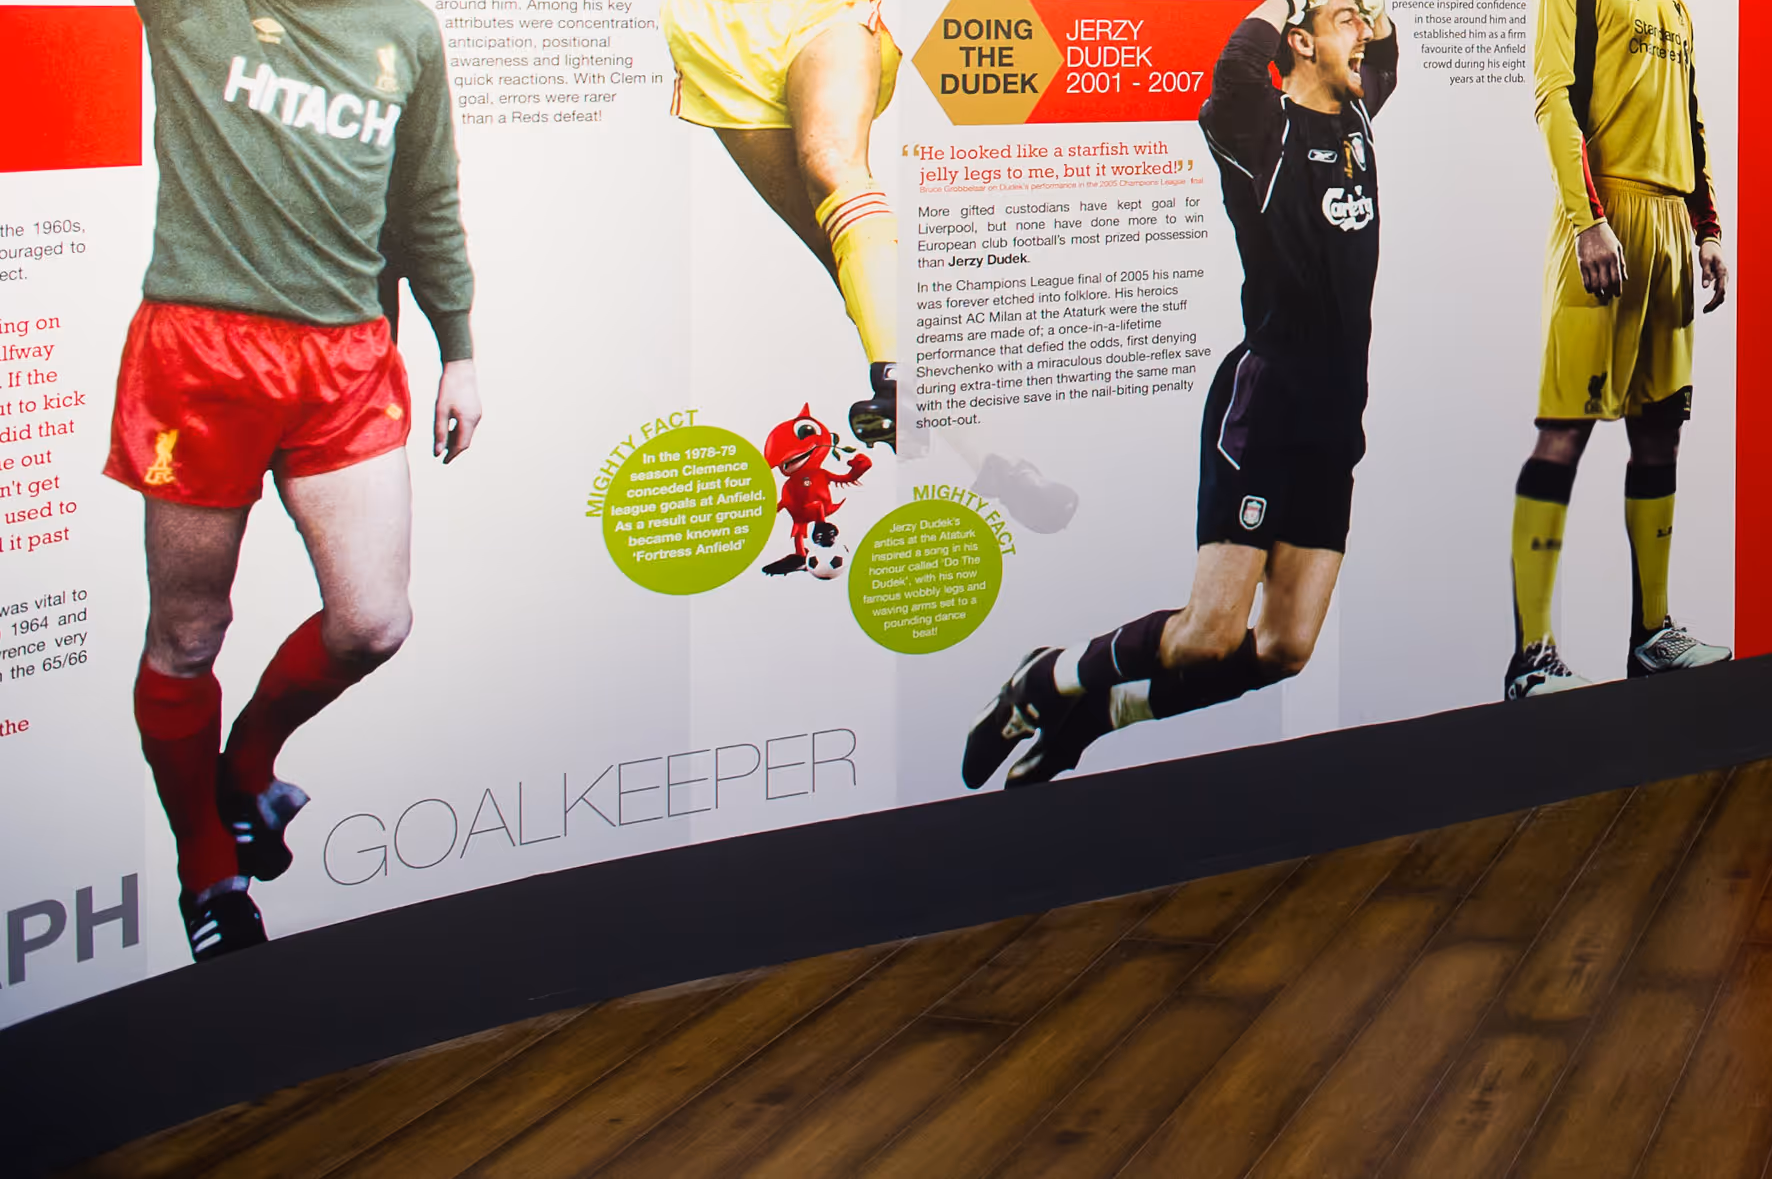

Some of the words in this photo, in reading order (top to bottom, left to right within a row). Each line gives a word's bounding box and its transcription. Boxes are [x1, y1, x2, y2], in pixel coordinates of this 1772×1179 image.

[944, 19, 1032, 40] DOING
[1066, 19, 1144, 41] JERZY
[959, 46, 1014, 67] THE
[1066, 46, 1152, 68] DUDEK
[941, 73, 1039, 94] DUDEK
[1066, 72, 1120, 93] 2001
[1149, 71, 1204, 92] 2007
[919, 167, 959, 185] jelly
[964, 166, 1001, 184] legs
[1007, 167, 1022, 179] to
[1028, 168, 1058, 180] me,
[1063, 164, 1091, 177] but
[1096, 163, 1106, 176] it
[34, 220, 85, 234] 1960s,
[918, 258, 944, 268] than
[948, 256, 983, 268] Jerzy
[988, 253, 1030, 265] Dudek.
[8, 371, 21, 388] If
[27, 369, 57, 385] the
[19, 400, 36, 413] to
[43, 391, 85, 410] kick
[586, 434, 636, 517] MIGHTY
[640, 409, 698, 439] FACT
[643, 454, 655, 464] In
[659, 452, 680, 462] the
[684, 445, 736, 460] 1978-79
[630, 469, 678, 481] season
[682, 462, 748, 476] Clemence
[626, 480, 693, 498] conceded
[696, 478, 721, 493] just
[724, 477, 752, 488] four
[611, 504, 656, 516] league
[660, 497, 696, 513] goals
[700, 495, 713, 507] at
[716, 490, 765, 508] Anfield.
[913, 485, 989, 512] MIGHTY
[985, 510, 1016, 556] FACT
[35, 591, 65, 609] vital
[72, 590, 87, 601] to
[12, 616, 48, 636] 1964
[58, 607, 87, 626] and
[10, 665, 35, 679] the
[43, 650, 87, 671] 65/66
[323, 728, 857, 885] GOALKEEPER
[0, 873, 140, 989] PH
